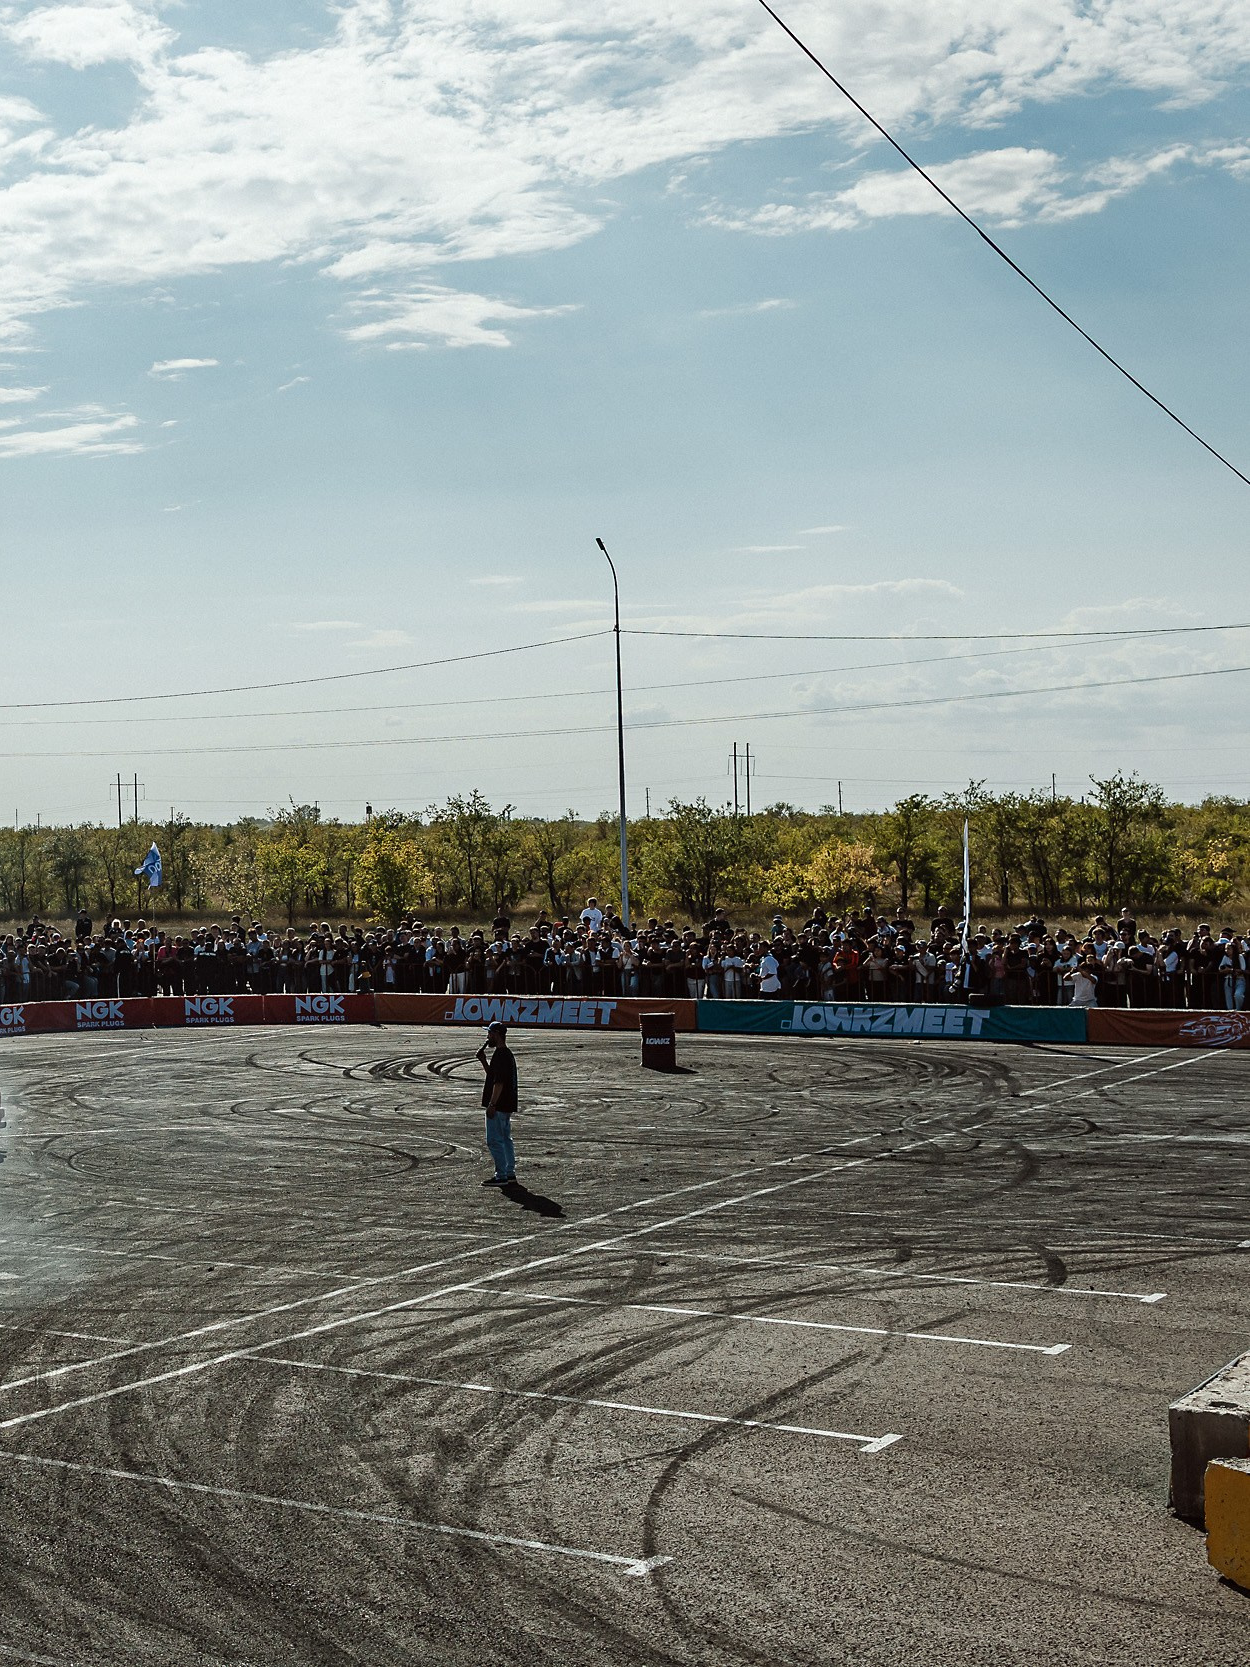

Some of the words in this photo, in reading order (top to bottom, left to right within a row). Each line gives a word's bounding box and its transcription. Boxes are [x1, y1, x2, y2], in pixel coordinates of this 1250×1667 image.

[75, 1000, 125, 1020] NGK
[184, 997, 235, 1016] NGK
[295, 995, 345, 1014] NGK
[7, 1025, 26, 1034] PLUGS
[76, 1020, 100, 1028] SPARK
